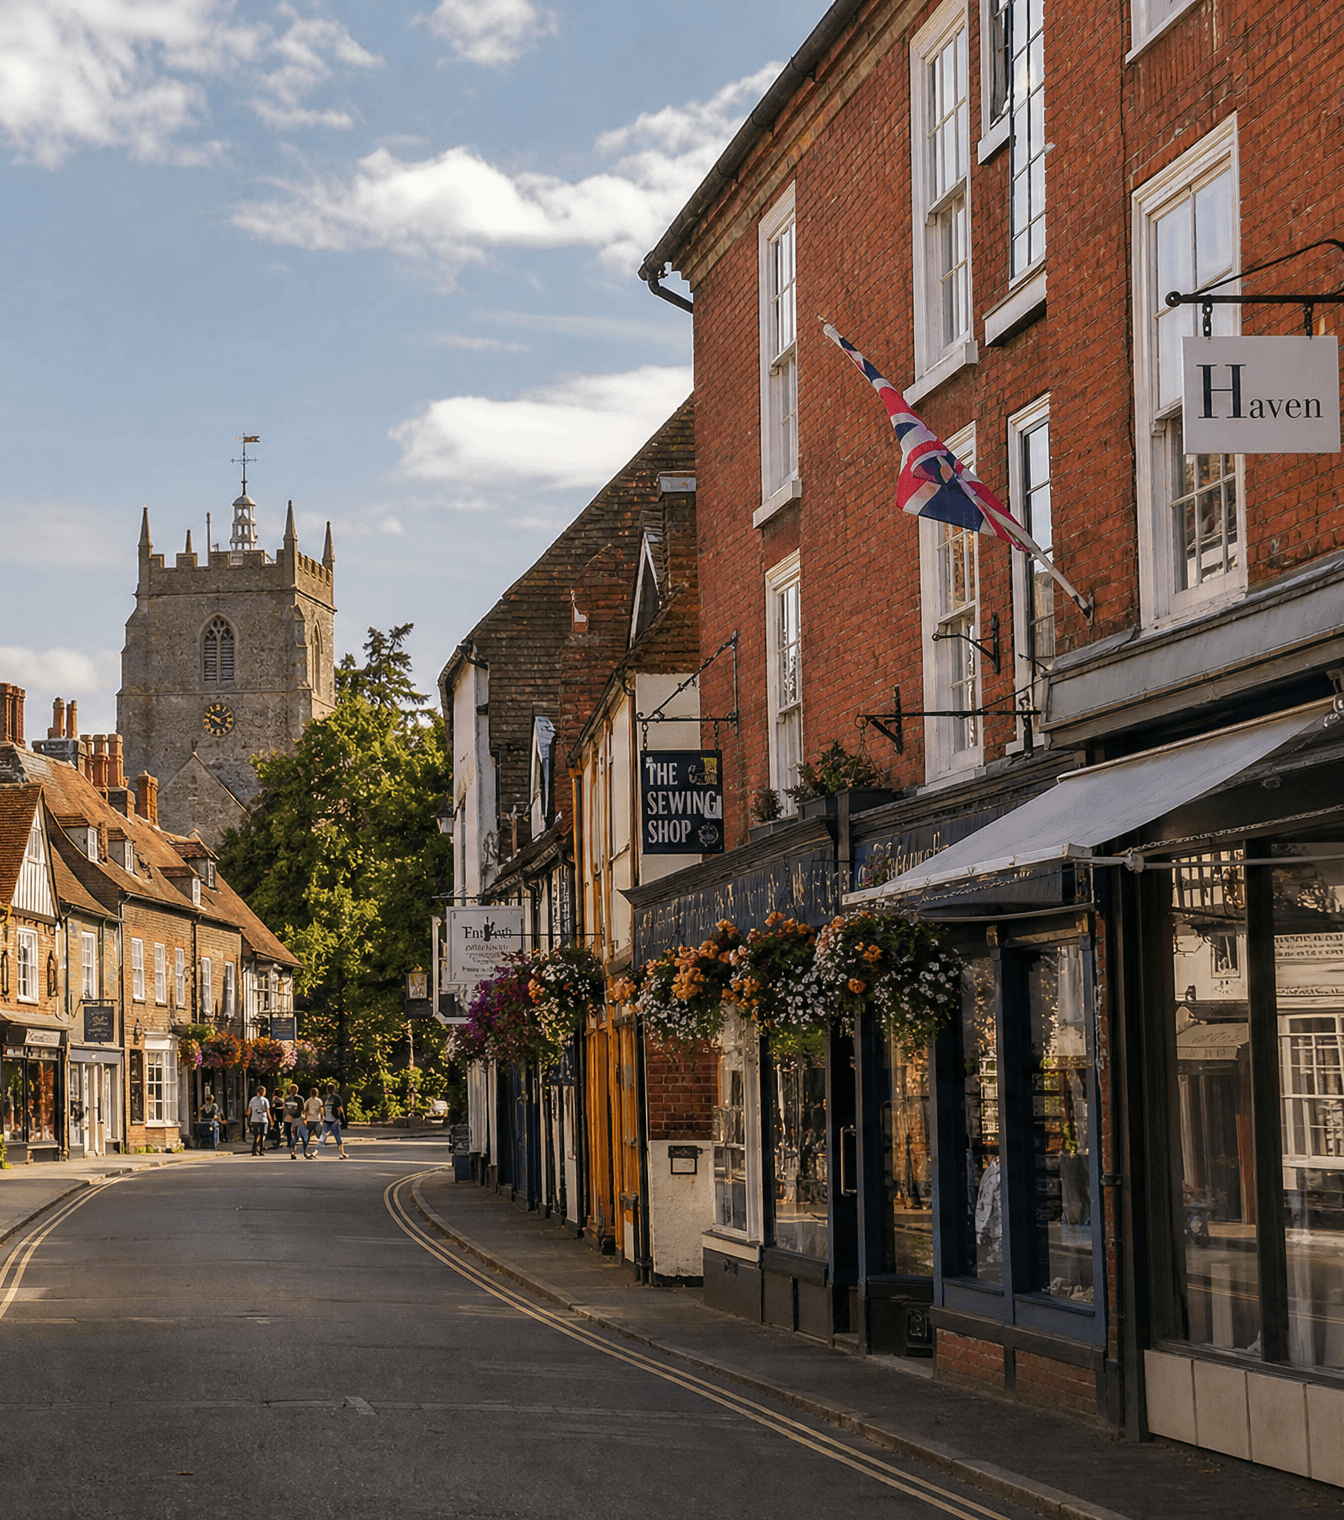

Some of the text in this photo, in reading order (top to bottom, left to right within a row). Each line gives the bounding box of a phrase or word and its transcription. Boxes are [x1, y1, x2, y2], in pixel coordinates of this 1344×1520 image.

[1196, 363, 1324, 419] Haven
[645, 762, 678, 786] THE
[647, 790, 717, 815] SEWING
[648, 819, 692, 844] SHOP
